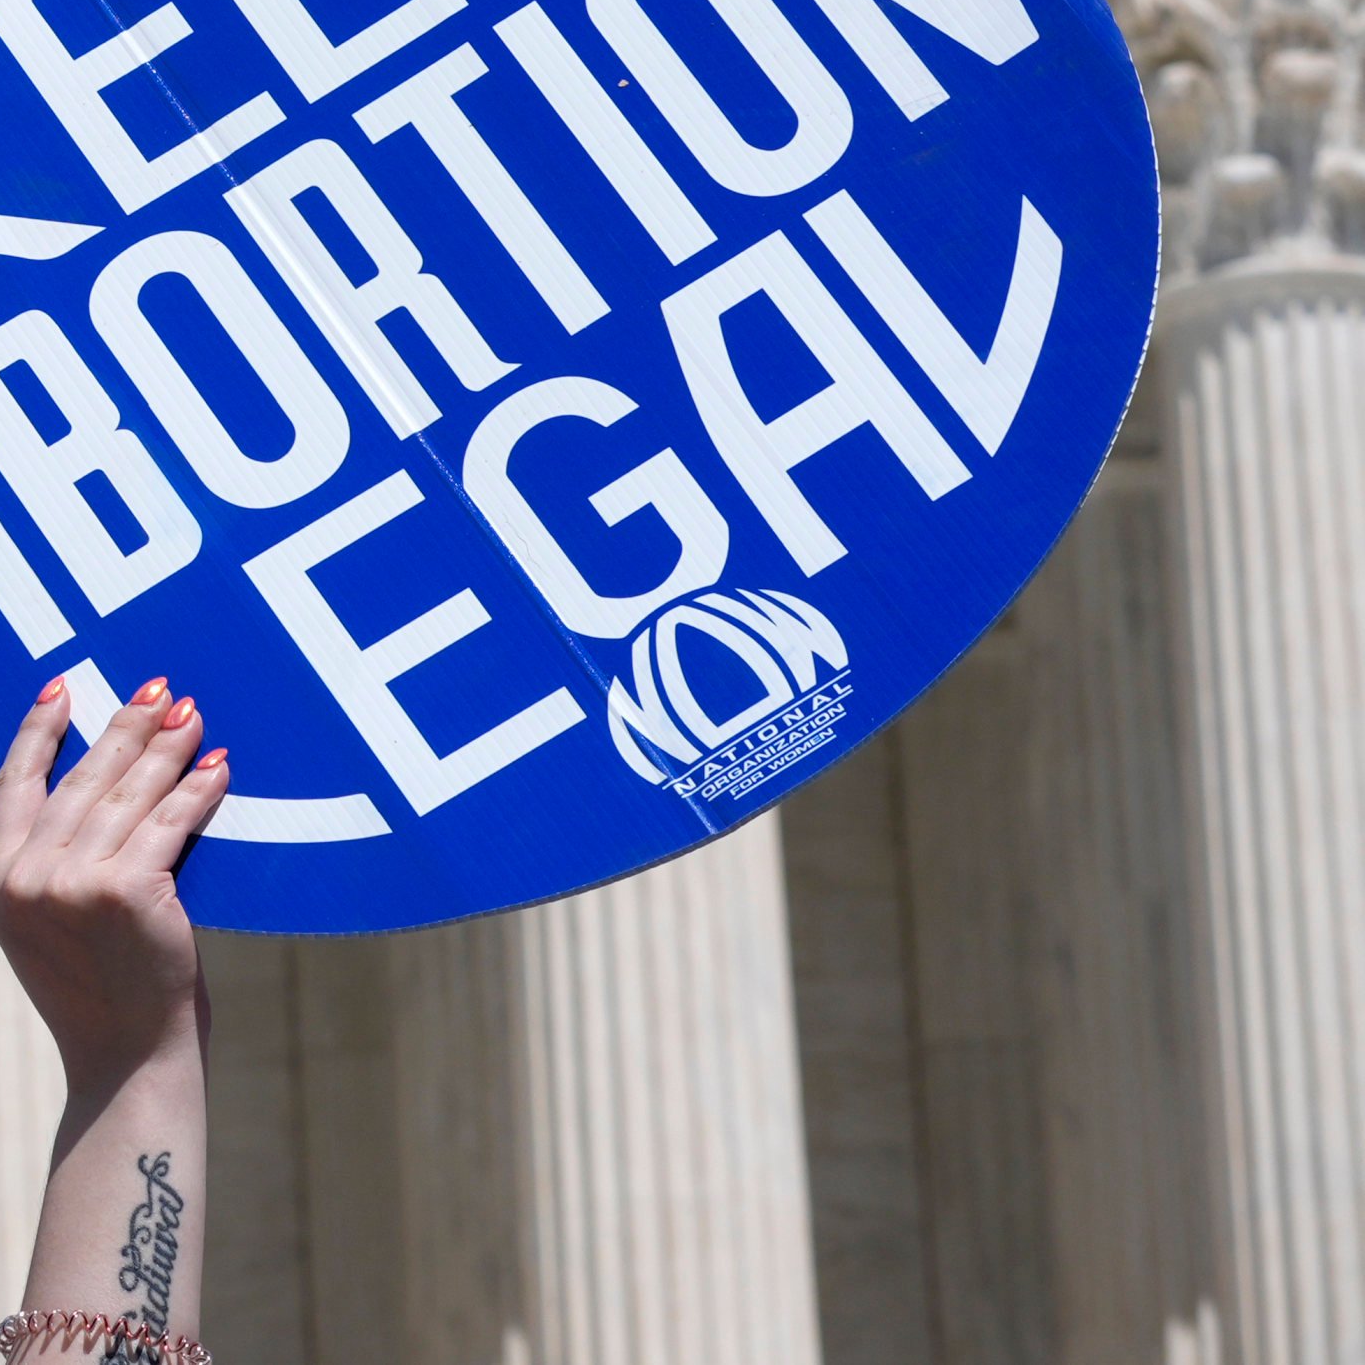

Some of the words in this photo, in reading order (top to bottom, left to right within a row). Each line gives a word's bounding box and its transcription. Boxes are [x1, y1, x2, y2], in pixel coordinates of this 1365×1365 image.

[62, 189, 1063, 843] LEGAL
[607, 587, 849, 786] NOW
[672, 682, 852, 795] NATIONAL
[701, 702, 845, 799] ORGANIZATION
[729, 770, 765, 797] FOR
[767, 726, 835, 771] WOMEN
